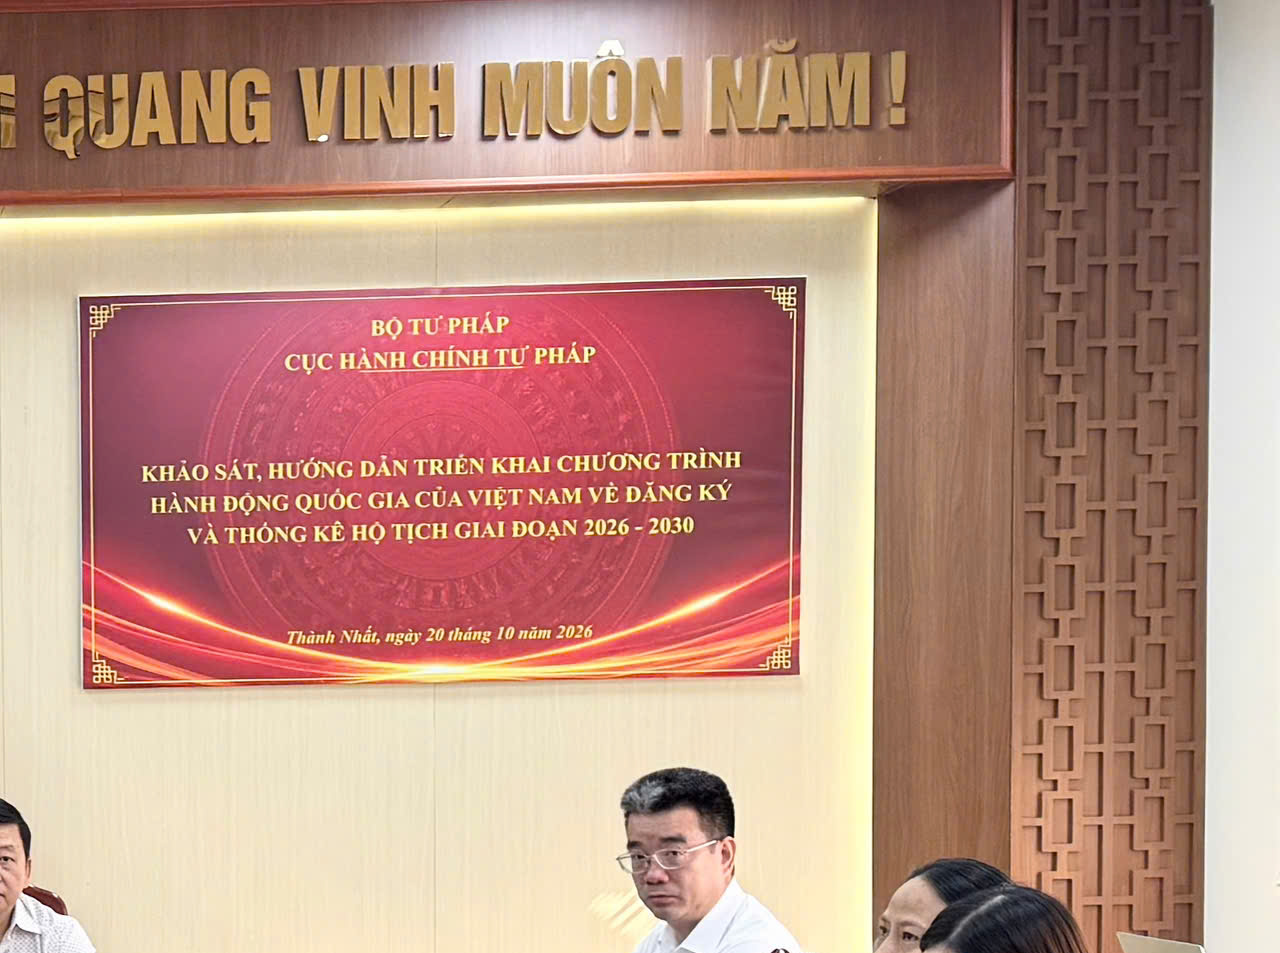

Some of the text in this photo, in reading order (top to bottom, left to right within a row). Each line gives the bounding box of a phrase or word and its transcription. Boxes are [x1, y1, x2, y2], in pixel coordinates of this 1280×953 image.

[42, 66, 272, 160] QUANG
[297, 62, 456, 142] VINH
[482, 40, 684, 137] MUÔN
[709, 38, 870, 131] NĂM
[371, 311, 510, 340] BỘ TƯ PHÁP
[284, 342, 596, 375] CỤC HÀNH CHÍNH TƯ PHÁP
[142, 461, 209, 482] KHẢO
[214, 460, 262, 482] SÁT,
[268, 459, 353, 480] HƯỚNG
[491, 456, 550, 474] KHAI
[557, 451, 661, 472] CHƯƠNG
[667, 448, 742, 469] TRÌNH
[151, 492, 216, 514] HÀNH
[223, 492, 289, 515] ĐỘNG
[368, 491, 409, 509] GIA
[415, 486, 463, 507] CỦA
[469, 486, 523, 510] VIỆT
[528, 487, 581, 505] NAM
[626, 480, 691, 503] ĐĂNG
[699, 479, 732, 501] KÝ
[187, 522, 219, 544] VÀ
[314, 521, 345, 542] KÊ
[352, 522, 386, 545] HỘ
[391, 523, 447, 545] TỊCH
[455, 521, 505, 538] GIAI
[512, 519, 578, 541] ĐOẠN
[584, 518, 629, 536] 2026
[649, 517, 694, 534] 2030
[287, 624, 593, 645] Thành Nhất, ngày 20 tháng 10 năm 2026
